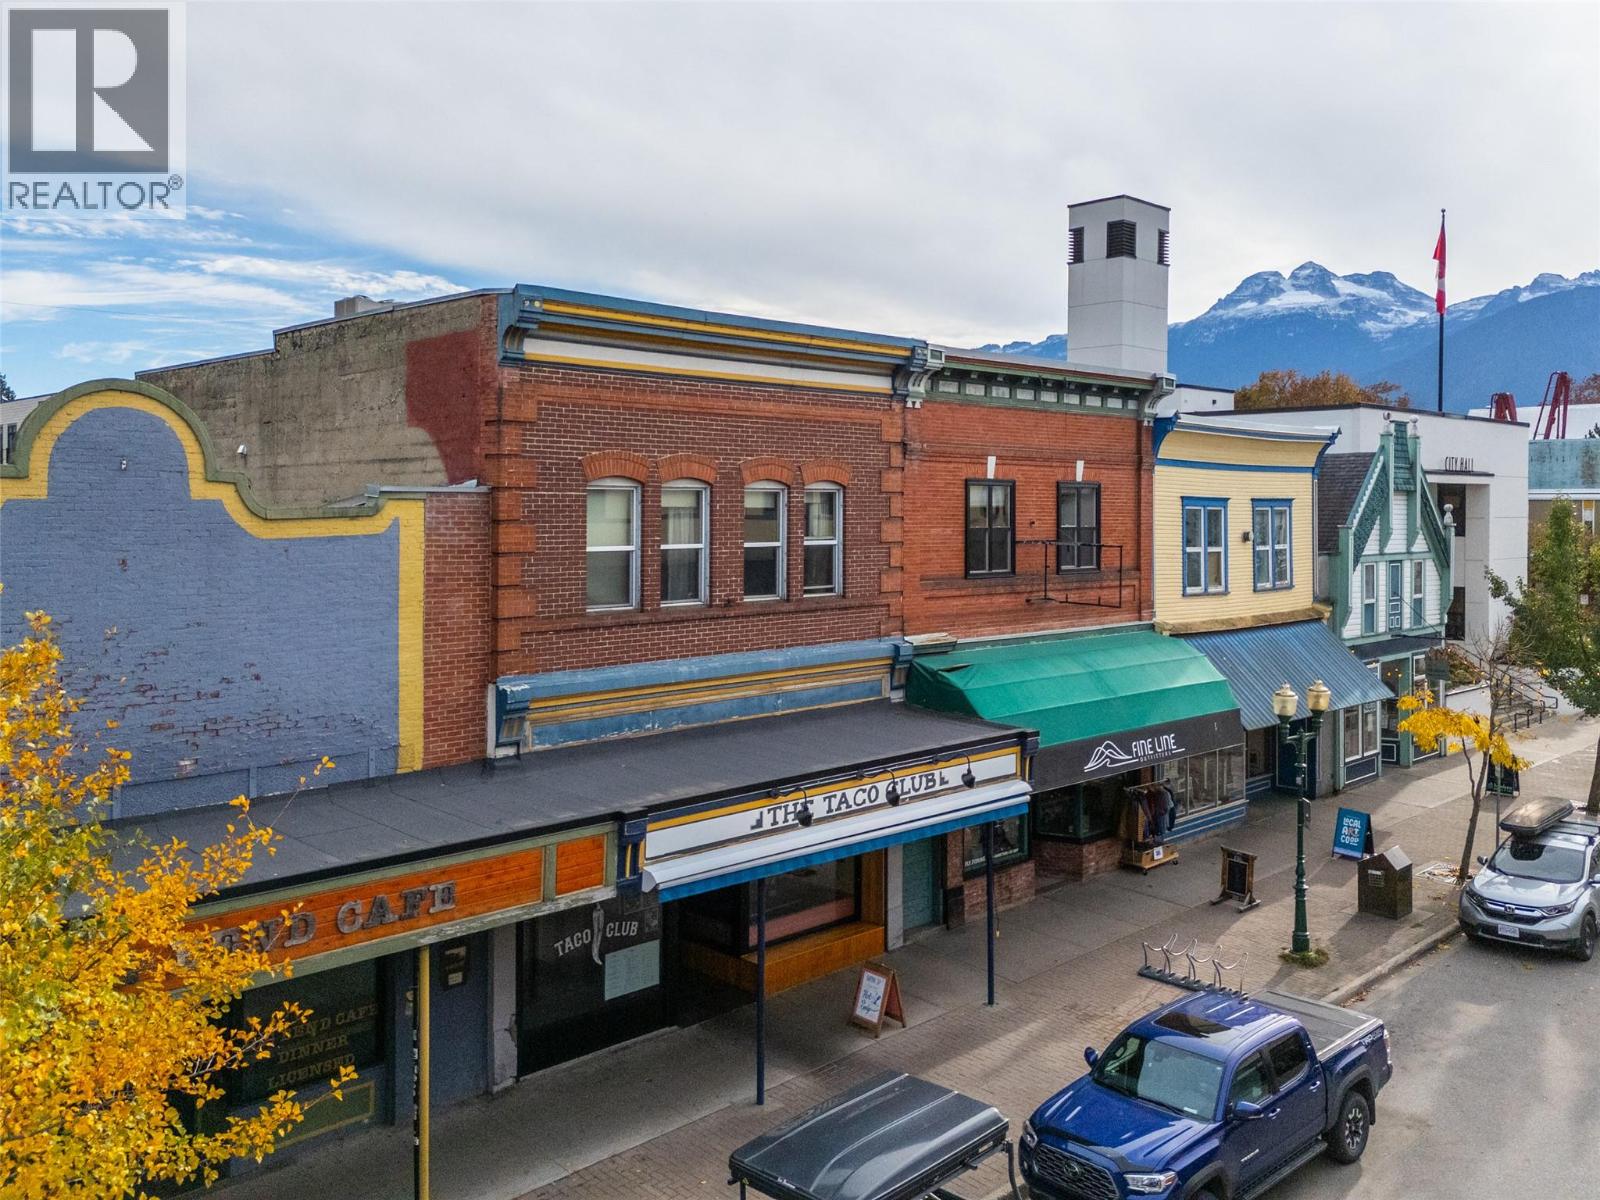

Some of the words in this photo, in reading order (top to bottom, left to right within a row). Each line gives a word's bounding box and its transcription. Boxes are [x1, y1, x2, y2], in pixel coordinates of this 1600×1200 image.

[1444, 456, 1459, 472] CITY
[1460, 456, 1474, 472] HALL
[1131, 738, 1154, 758] FINE
[1154, 732, 1177, 753] LINE
[823, 785, 880, 815] TACO
[1341, 826, 1360, 838] ART
[1343, 816, 1361, 829] LOCAL
[336, 880, 457, 935] CAFE
[553, 928, 592, 957] TACO
[605, 921, 639, 938] CLUB
[277, 1034, 349, 1064] DINNER
